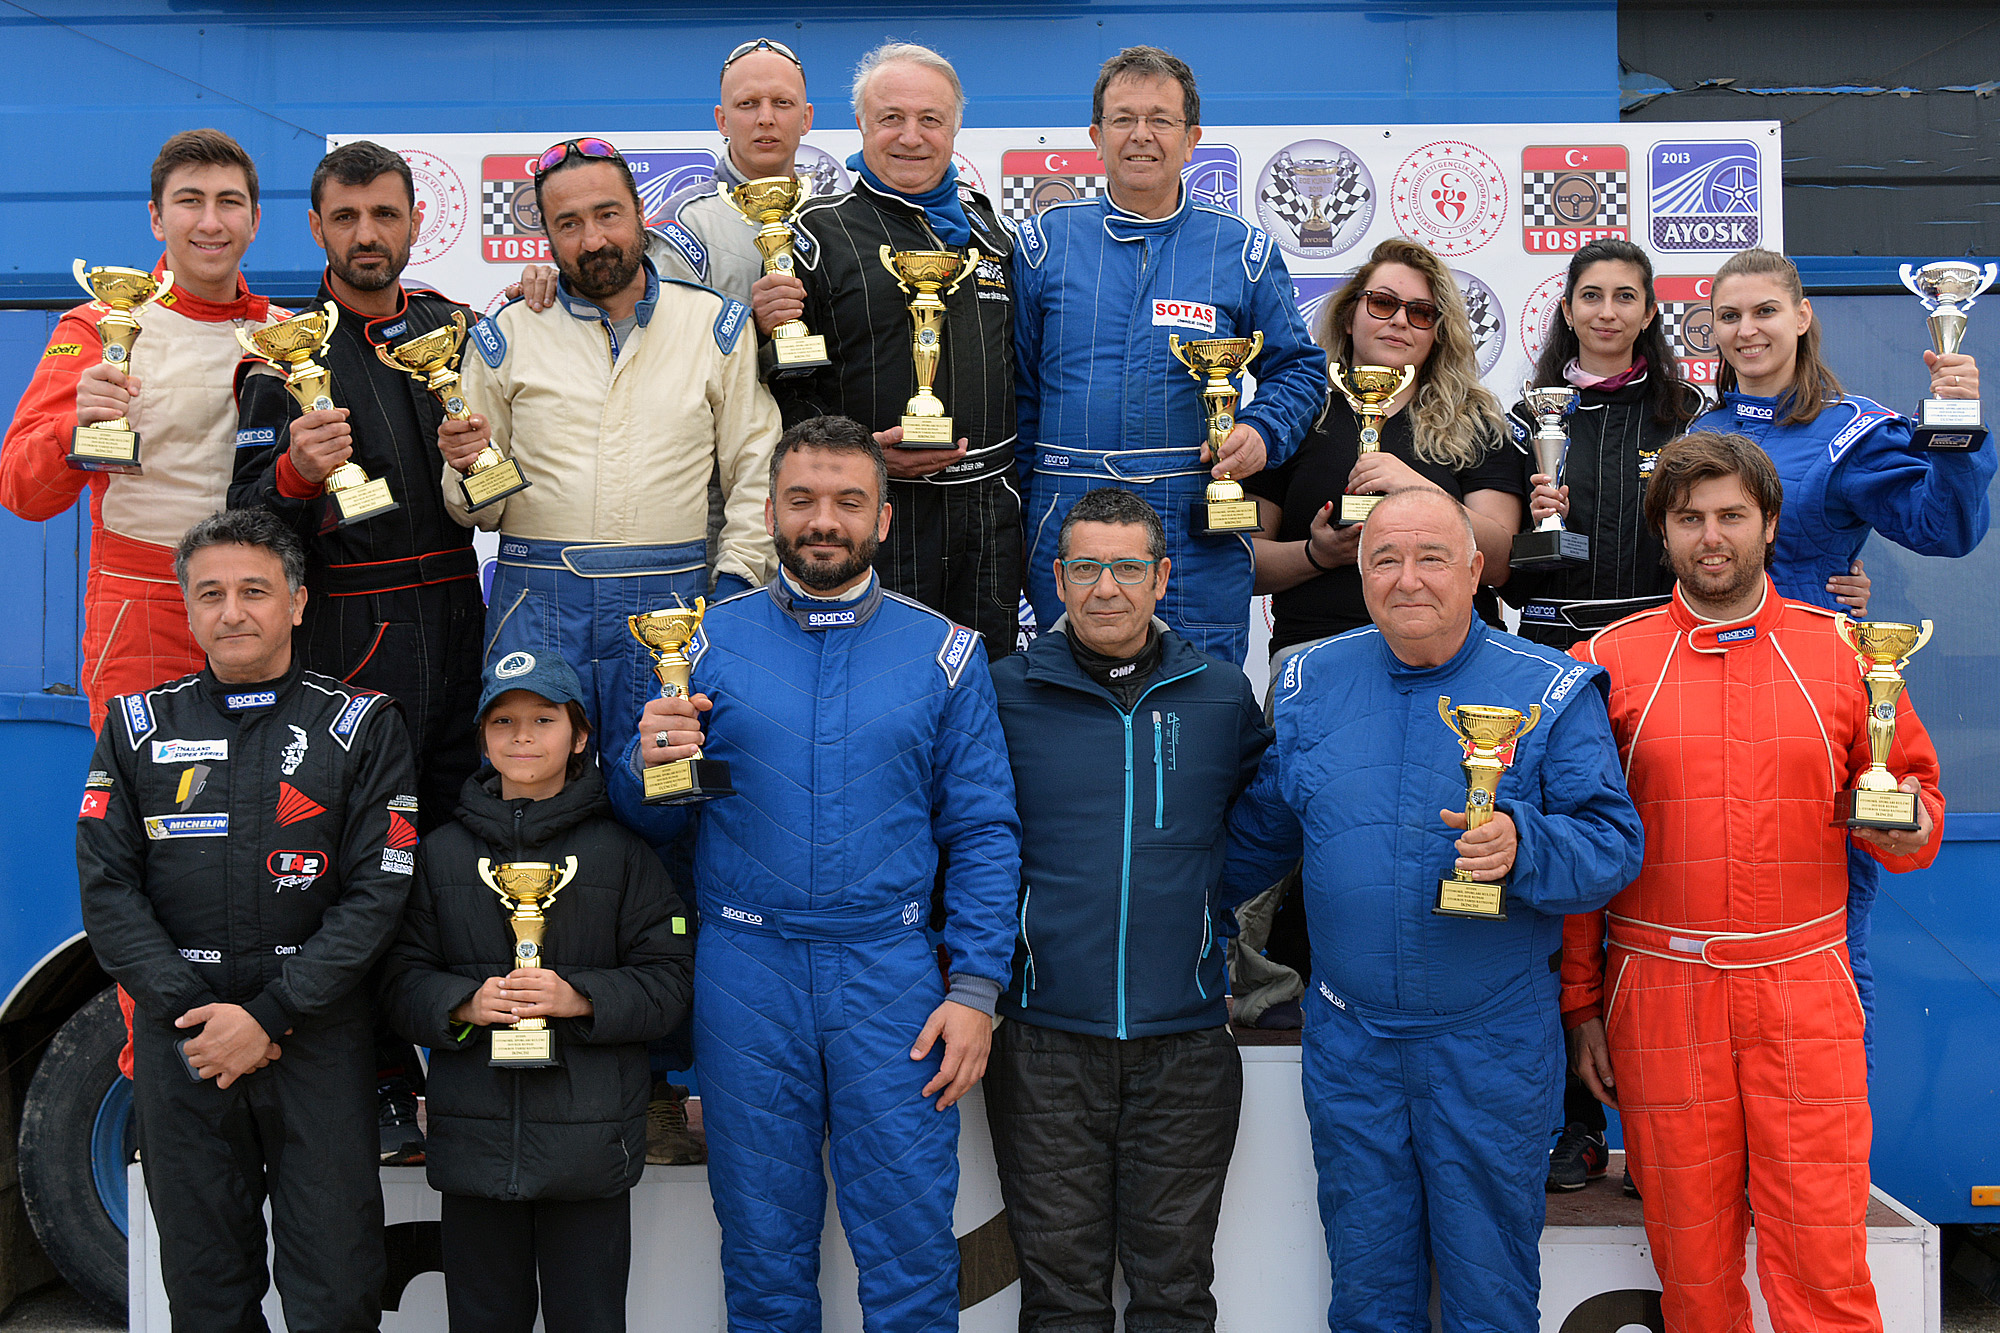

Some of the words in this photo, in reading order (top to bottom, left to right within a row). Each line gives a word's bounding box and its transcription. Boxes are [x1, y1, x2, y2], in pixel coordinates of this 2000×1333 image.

[630, 161, 650, 173] 013
[1661, 152, 1691, 165] 2013
[1438, 161, 1469, 171] GENÇLİK
[1470, 169, 1479, 180] VE
[1476, 179, 1486, 200] SPOR
[430, 179, 438, 188] VE
[437, 188, 446, 208] SPOR
[666, 224, 702, 263] sparco
[1271, 231, 1313, 256] Otomobil
[1662, 222, 1750, 245] AYOSK
[488, 239, 552, 259] TOSF
[719, 300, 744, 338] sparco
[1735, 403, 1774, 420] sparco
[1833, 414, 1874, 448] sparco
[1043, 453, 1070, 467] sparco
[502, 542, 528, 557] sparco
[809, 612, 854, 627] sparco
[1526, 605, 1556, 617] sparco
[1717, 627, 1755, 642] sparco
[946, 629, 970, 667] sparco
[1109, 664, 1136, 679] OMP
[1550, 664, 1585, 701] sparco
[227, 692, 276, 708] sparco
[129, 694, 149, 732] sparco
[336, 696, 368, 734] sparco
[169, 819, 227, 829] MICHELIN
[280, 853, 319, 874] TA2
[383, 847, 414, 865] KARA
[271, 874, 320, 894] Racing
[722, 906, 763, 926] sparco
[274, 945, 297, 955] Cem
